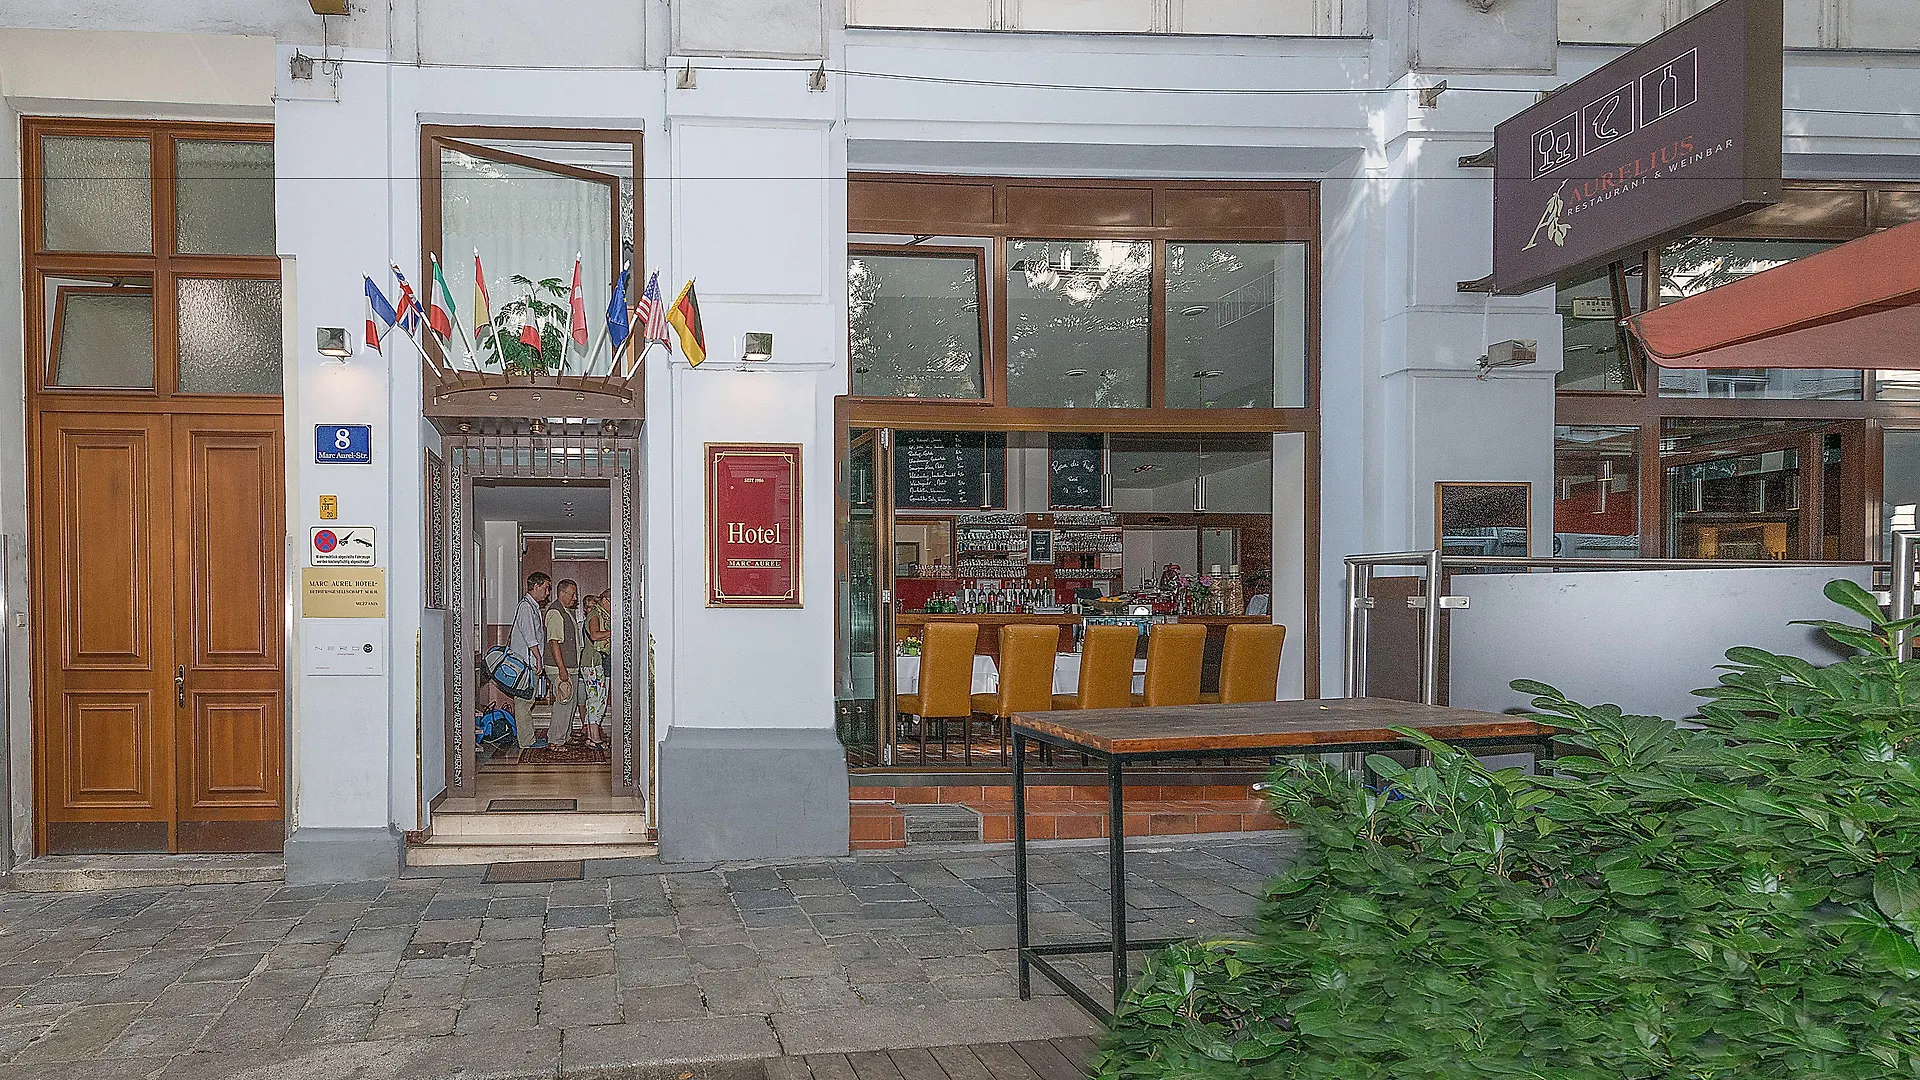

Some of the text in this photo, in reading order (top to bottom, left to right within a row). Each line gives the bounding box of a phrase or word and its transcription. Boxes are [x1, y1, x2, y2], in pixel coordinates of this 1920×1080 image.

[1567, 138, 1734, 216] RESTAURANT & WEINBAR
[1568, 135, 1694, 206] AURELIUS
[334, 428, 351, 450] 8
[318, 451, 369, 459] Marc Aurel-Str.
[727, 522, 782, 544] Hotel
